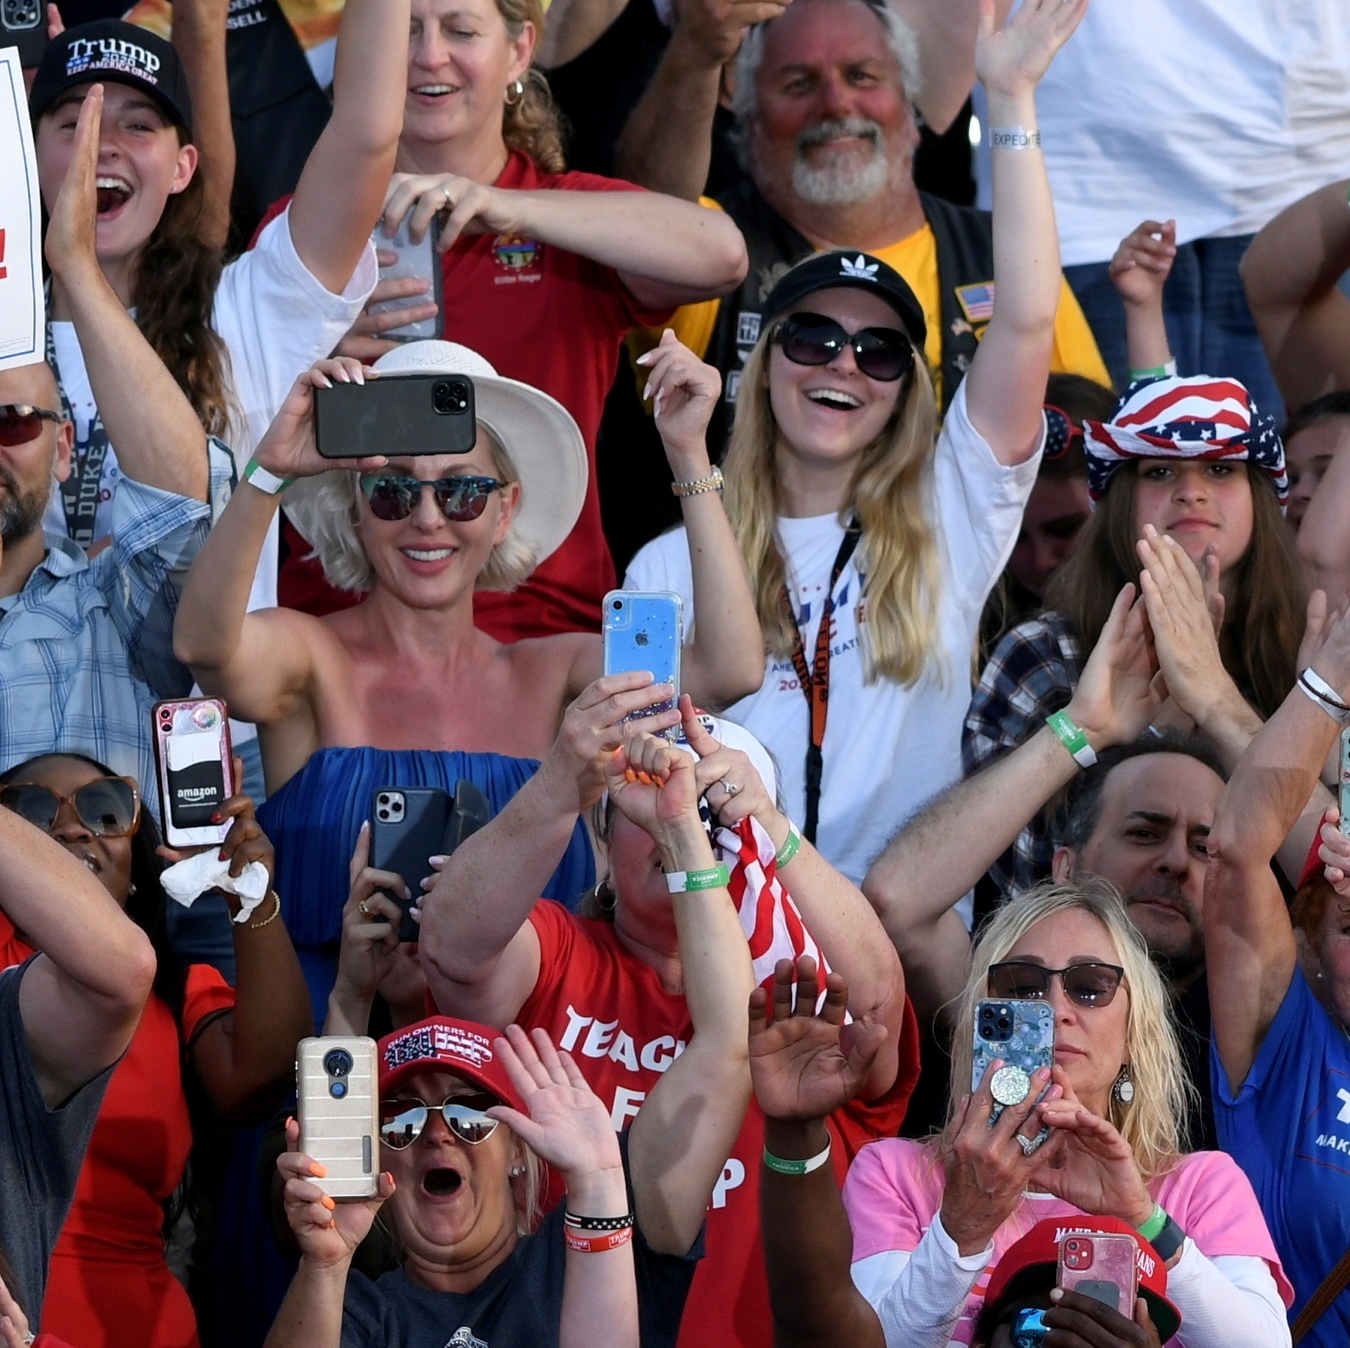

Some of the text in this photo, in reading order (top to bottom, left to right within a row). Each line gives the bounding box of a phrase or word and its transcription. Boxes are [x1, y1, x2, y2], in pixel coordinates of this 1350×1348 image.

[67, 38, 161, 73] Trump
[88, 61, 126, 72] AMERICA
[103, 53, 136, 66] 2020
[77, 443, 105, 516] DUKE
[828, 637, 861, 660] REAT!
[177, 786, 217, 800] amazon
[387, 1024, 491, 1049] GUN OWNERS FOR
